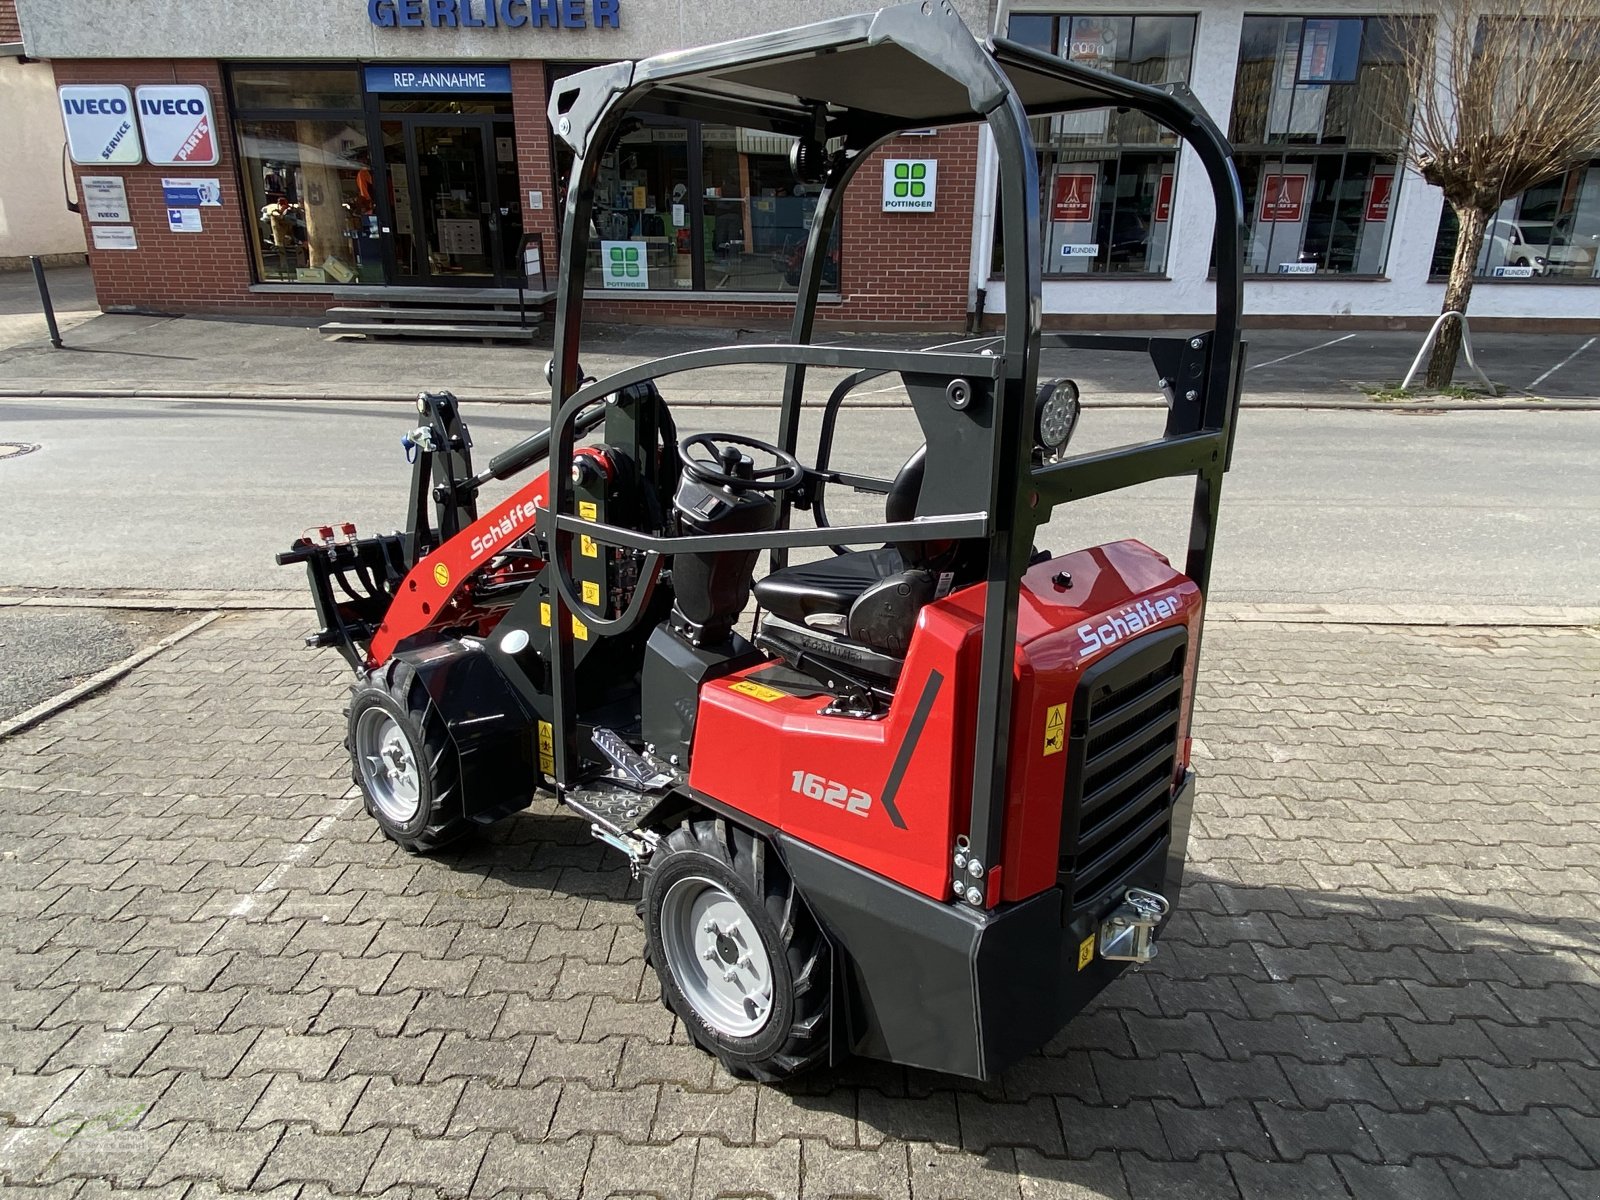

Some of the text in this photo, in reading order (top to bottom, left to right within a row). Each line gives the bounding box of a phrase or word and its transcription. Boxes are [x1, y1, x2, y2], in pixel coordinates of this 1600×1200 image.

[368, 0, 620, 28] GERLICHER
[394, 72, 486, 89] REP.-ANNAHME
[64, 99, 127, 115] IVECO
[140, 99, 204, 116] IVECO
[101, 121, 131, 160] SERVICE
[178, 122, 209, 161] PARTS
[1289, 265, 1315, 273] KUNDEN
[470, 494, 542, 560] Schäffer
[1077, 595, 1178, 657] Schäffer
[791, 770, 873, 818] 1622
